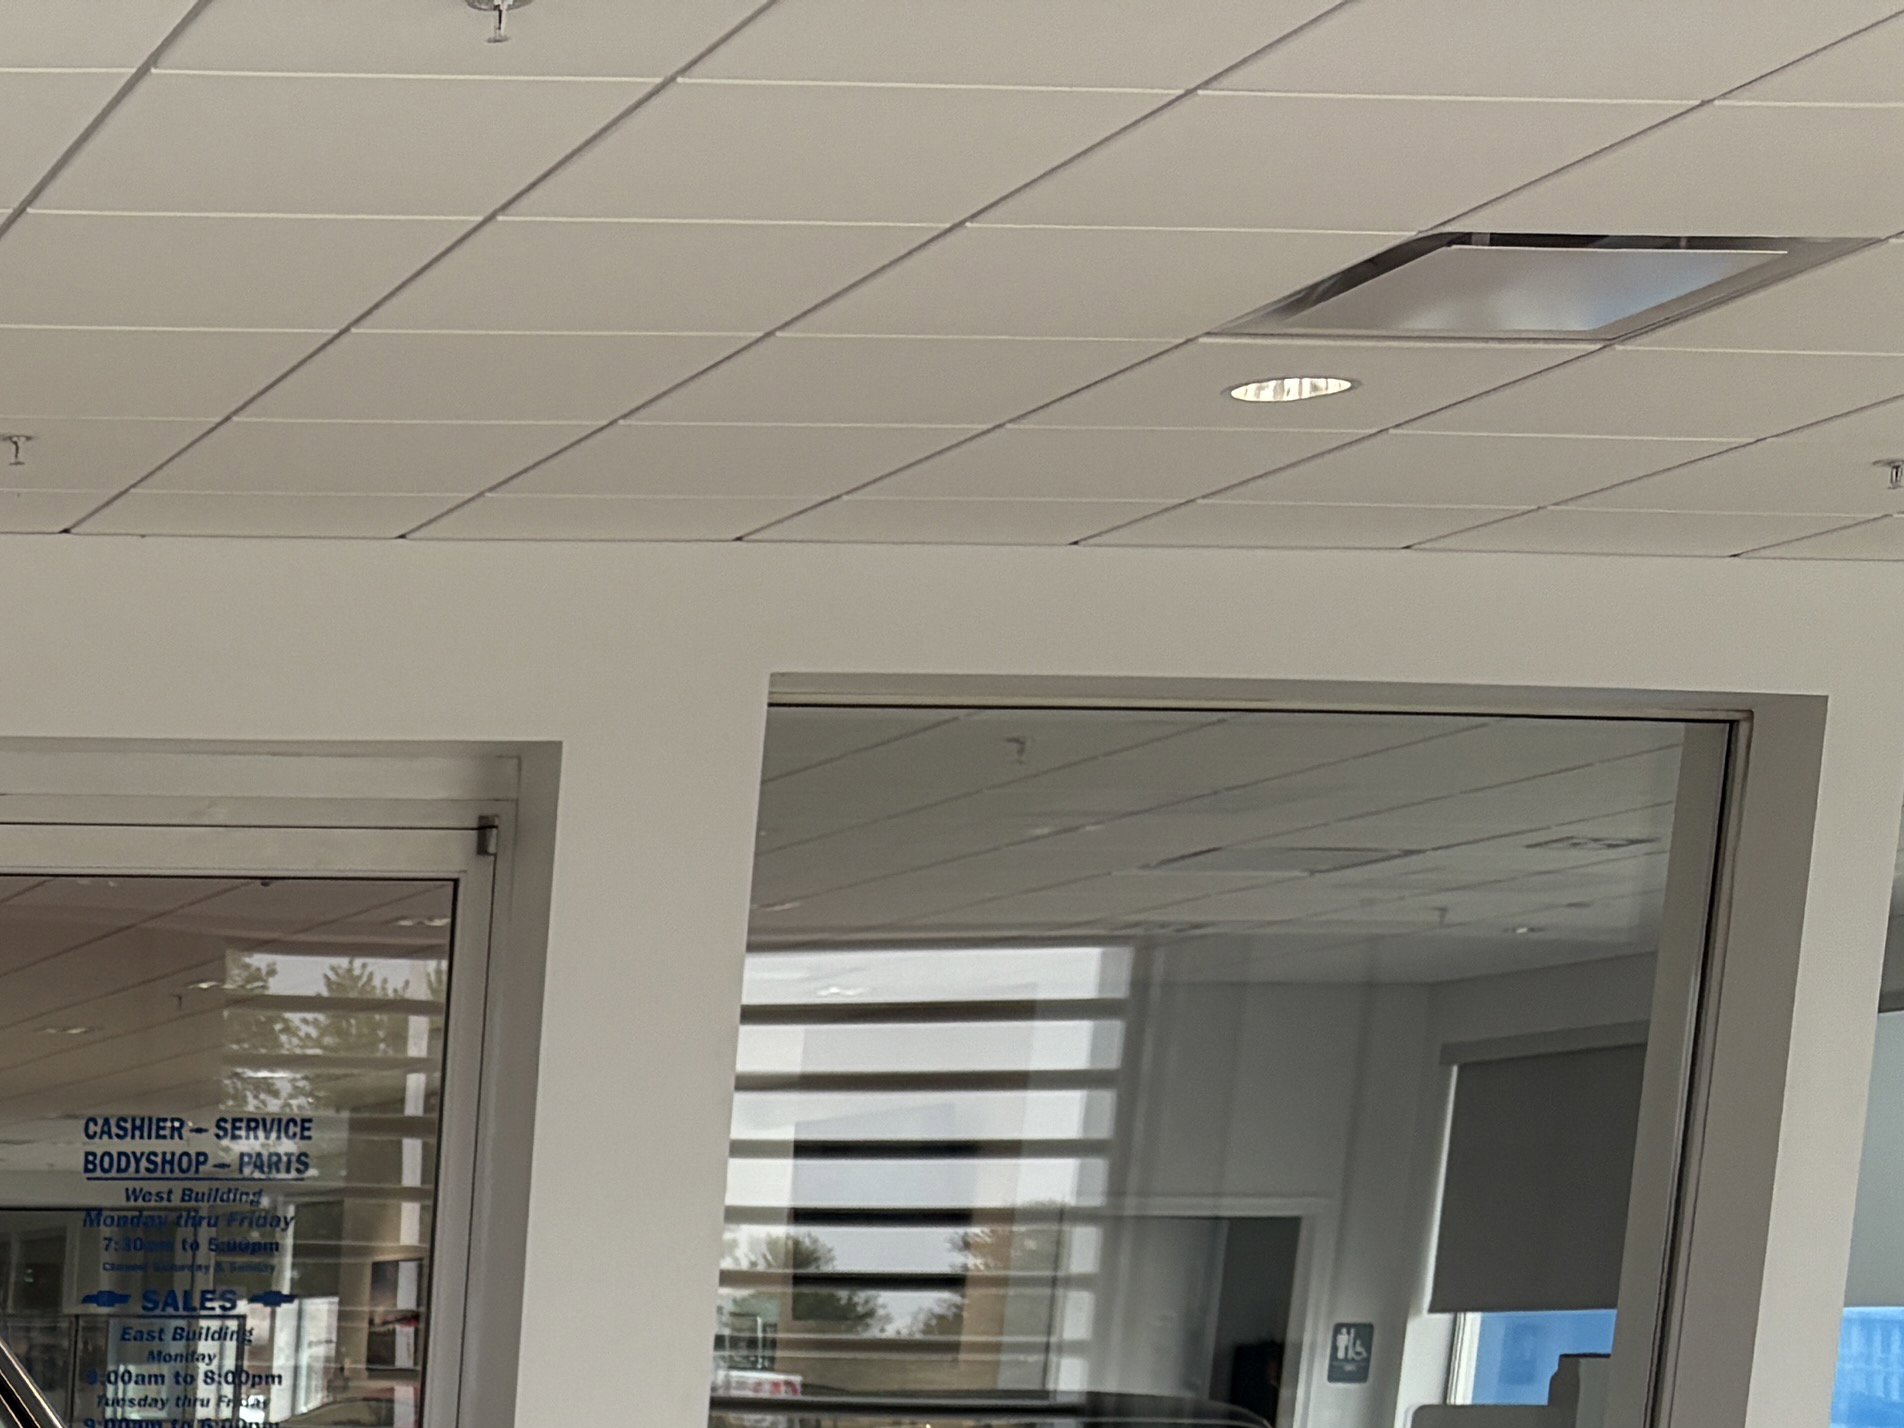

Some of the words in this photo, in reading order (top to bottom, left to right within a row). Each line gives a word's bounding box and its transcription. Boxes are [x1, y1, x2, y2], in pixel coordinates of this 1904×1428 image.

[84, 1116, 185, 1141] CASHIER
[214, 1116, 314, 1141] SERVICE
[83, 1150, 209, 1175] BODYSHOP
[239, 1151, 310, 1175] PARTS
[124, 1187, 174, 1204] West
[180, 1186, 264, 1207] Building
[83, 1209, 169, 1232] Monday
[176, 1208, 219, 1229] thru
[226, 1209, 295, 1233] Friday
[181, 1237, 201, 1253] to
[141, 1288, 239, 1313] SALES
[120, 1326, 165, 1342] East
[171, 1326, 255, 1345] Building
[146, 1350, 217, 1366] Monday
[174, 1370, 196, 1386] to
[202, 1369, 283, 1388] 8:00pm
[217, 1395, 270, 1409] Frday
